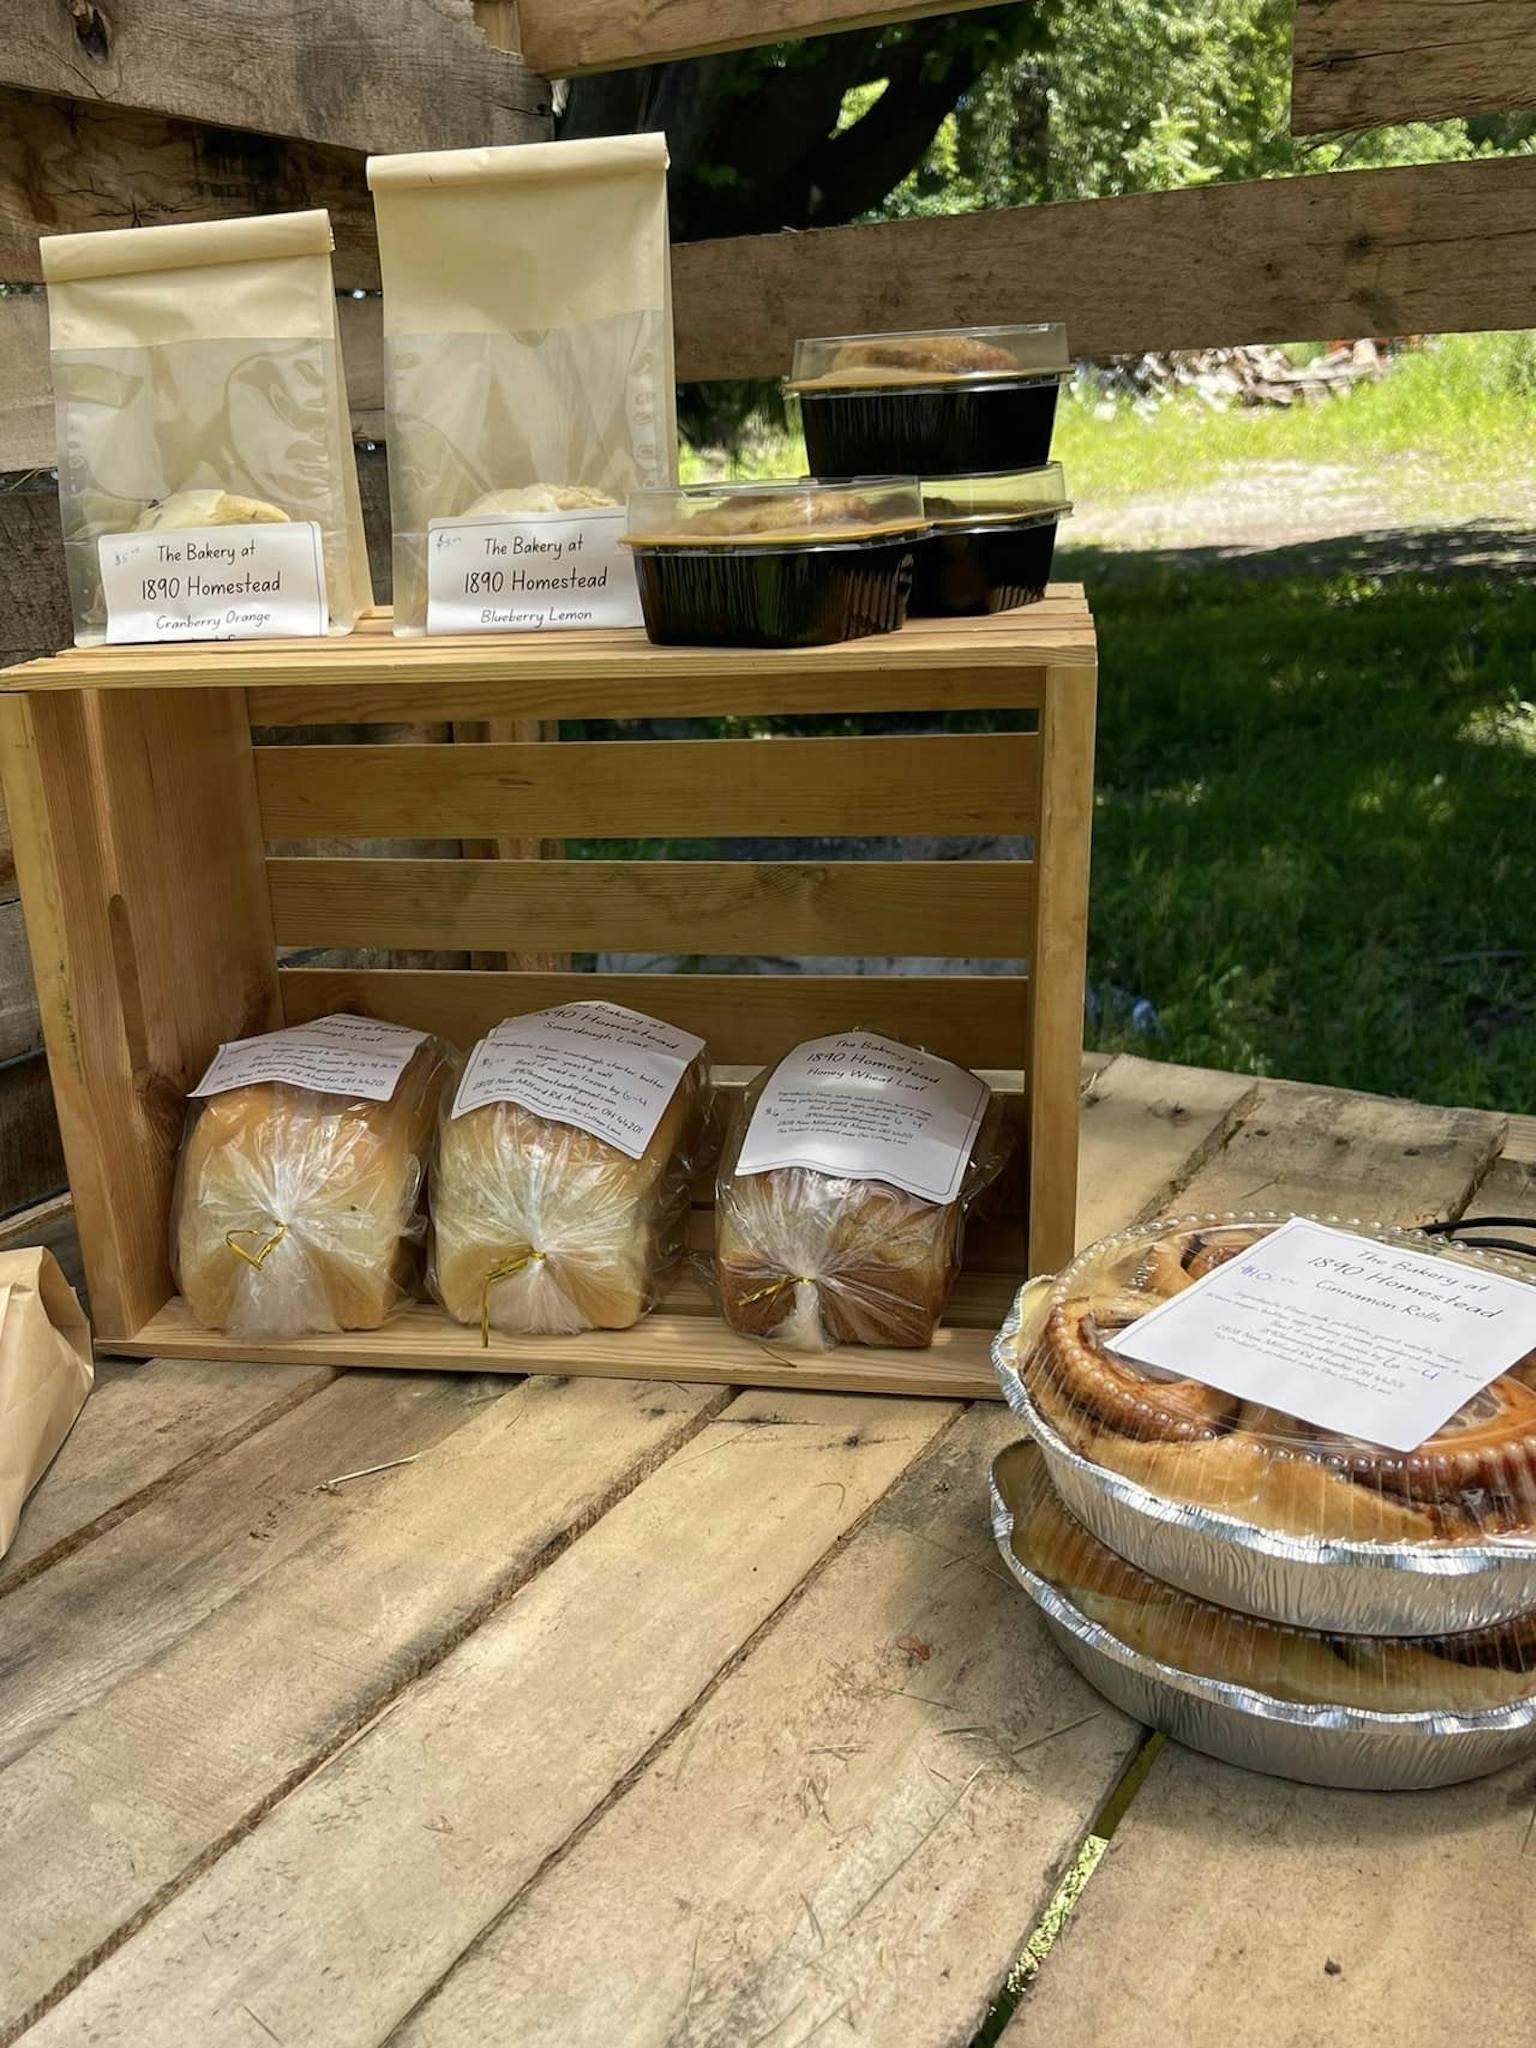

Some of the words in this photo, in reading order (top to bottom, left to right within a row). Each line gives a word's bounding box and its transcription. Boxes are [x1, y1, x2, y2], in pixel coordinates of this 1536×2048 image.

[157, 544, 182, 563] The
[186, 542, 236, 566] Bakery
[240, 539, 256, 556] at
[484, 537, 508, 556] The
[512, 535, 563, 561] Bakery
[567, 533, 585, 551] at
[142, 576, 181, 600] 1890
[187, 571, 281, 597] Homestead
[464, 570, 504, 594] 1890
[511, 566, 608, 591] Homestead
[155, 613, 222, 630] Cranberry
[225, 610, 272, 629] Orange
[480, 608, 545, 629] Blueberry
[548, 606, 593, 622] Lemon
[543, 1020, 613, 1041] Sourdough
[616, 1035, 649, 1049] Loaf
[580, 1012, 680, 1049] Homestead
[834, 1039, 857, 1049] The
[806, 1051, 846, 1063] 1890
[850, 1053, 942, 1084] Homestead
[806, 1067, 846, 1078] Honey
[850, 1069, 894, 1084] Wheat
[895, 1078, 928, 1093] Loaf
[1356, 1250, 1389, 1266] The
[1391, 1261, 1459, 1287] Bakery
[1464, 1283, 1492, 1294] at
[1307, 1256, 1365, 1277] 1890
[1365, 1272, 1505, 1319] Homestead
[1315, 1279, 1397, 1310] Cinnamon
[1401, 1304, 1443, 1323] Rolls
